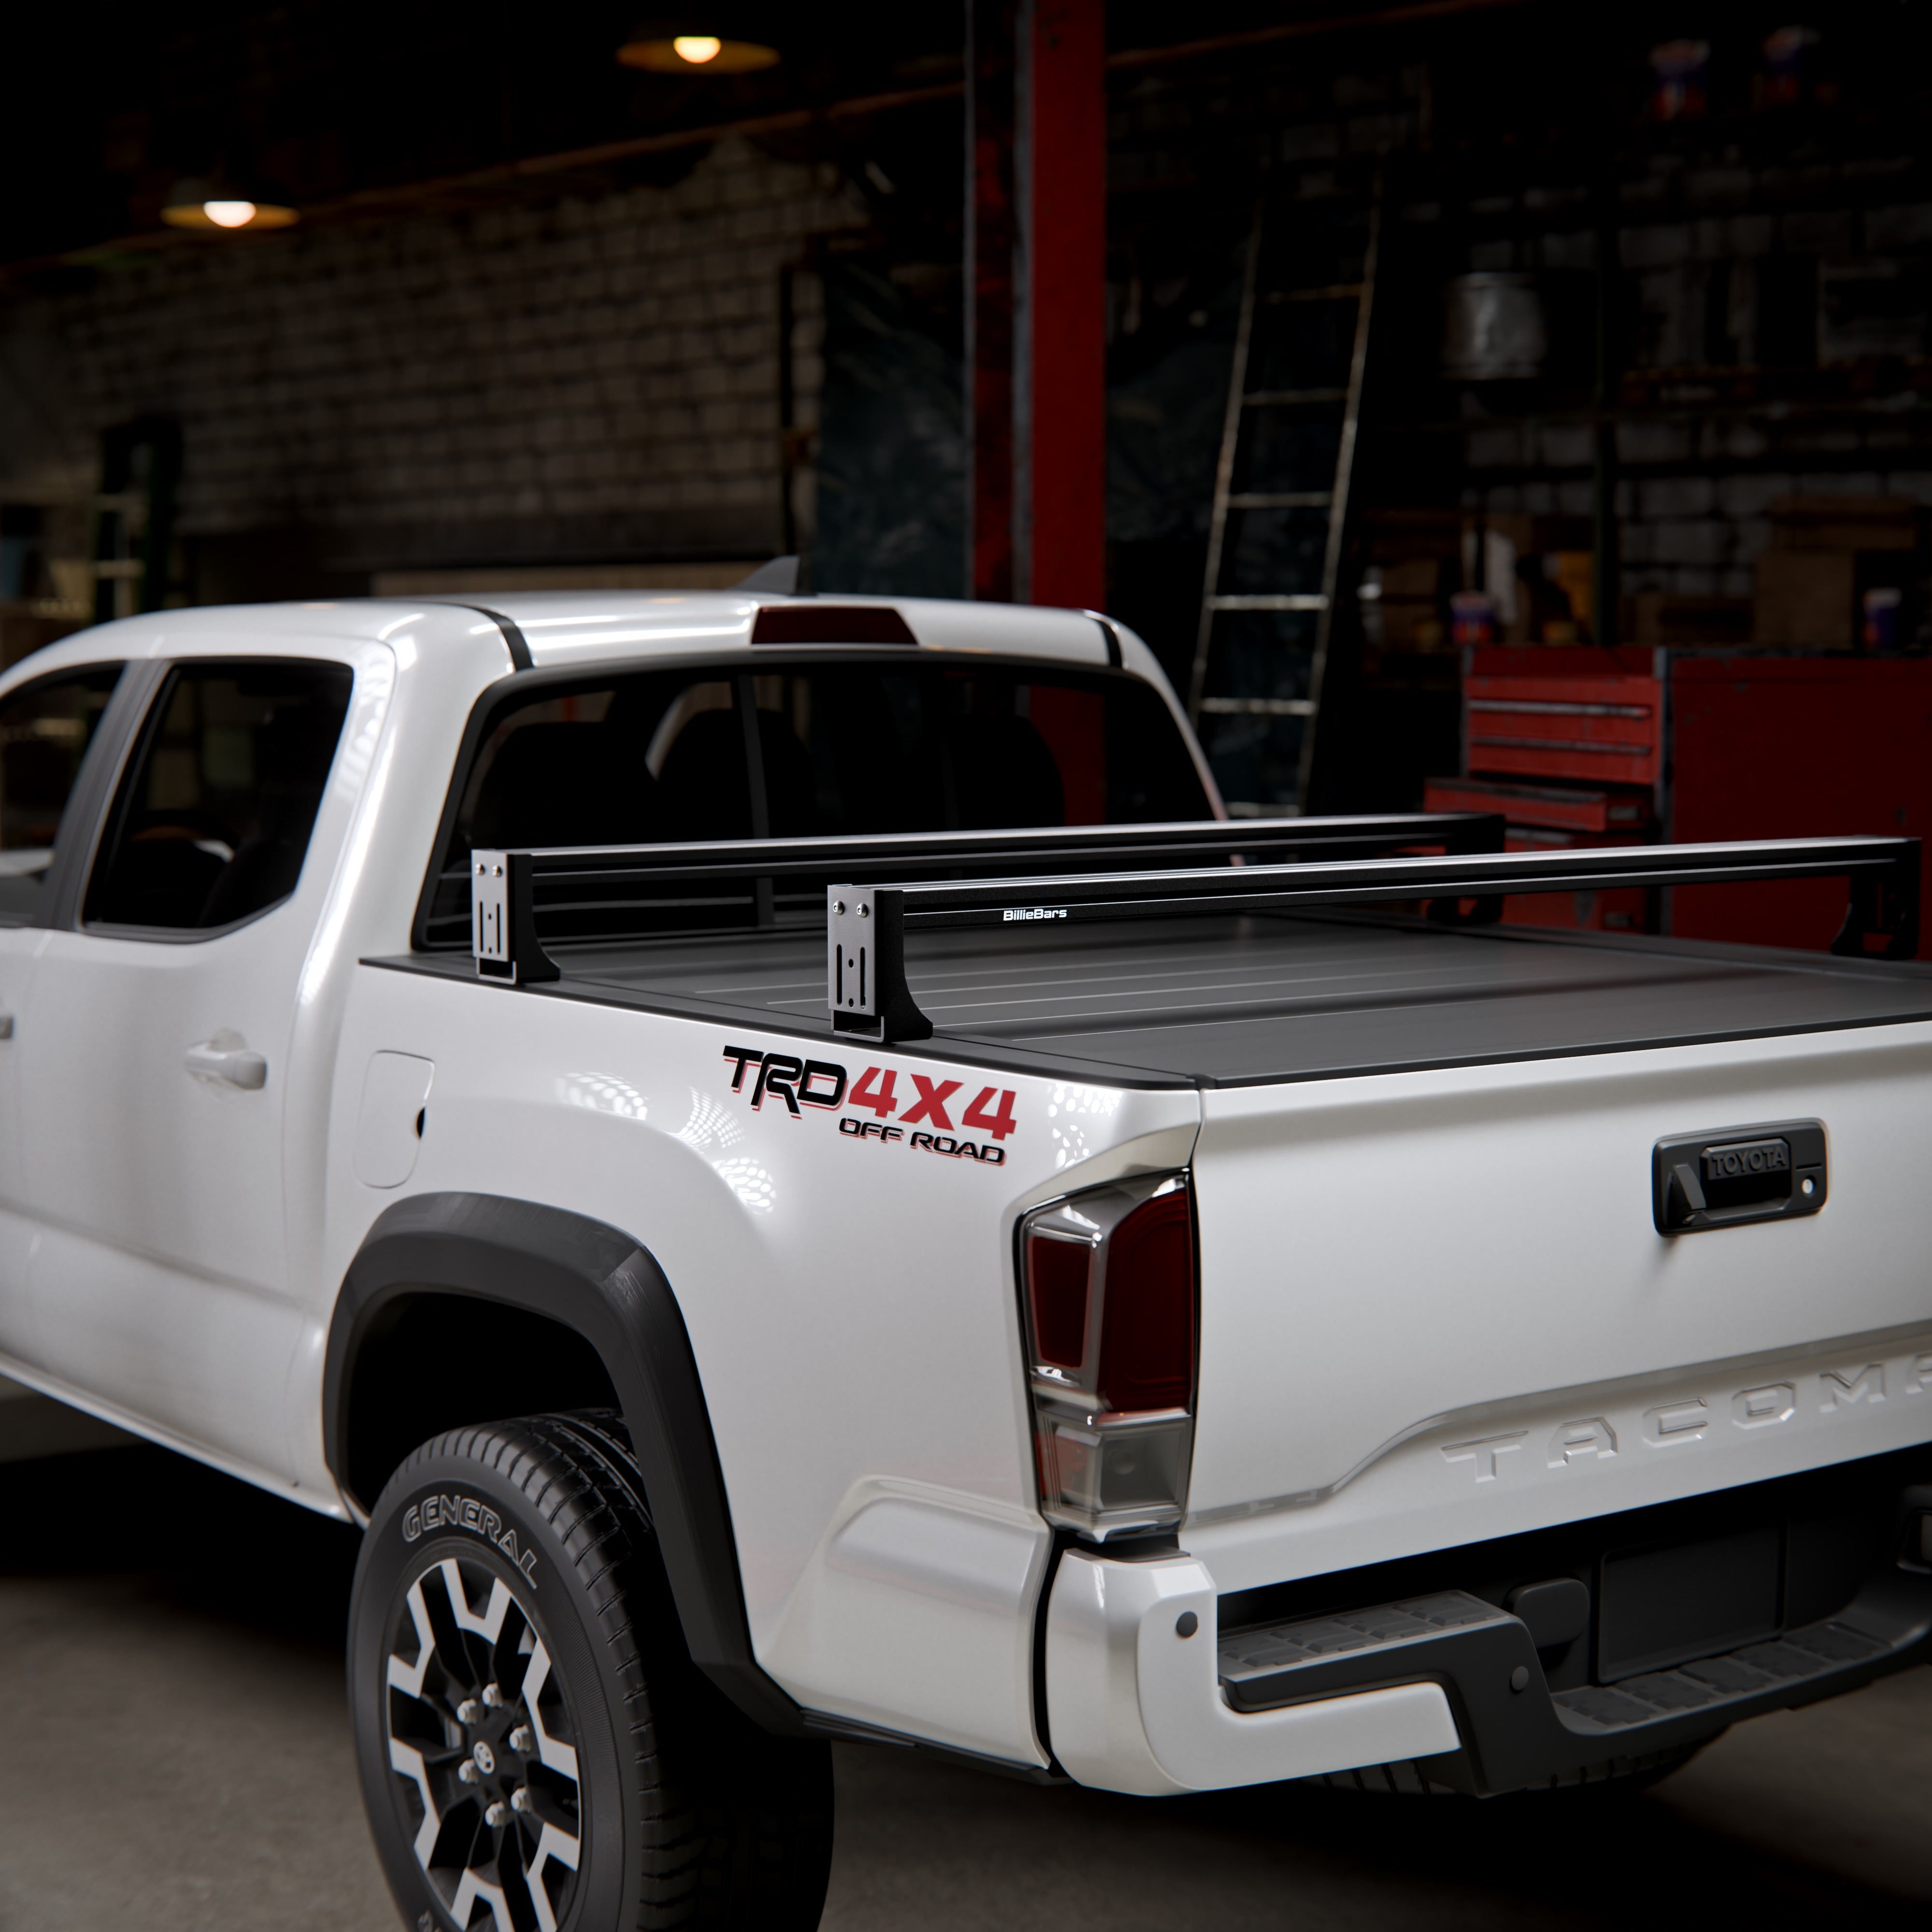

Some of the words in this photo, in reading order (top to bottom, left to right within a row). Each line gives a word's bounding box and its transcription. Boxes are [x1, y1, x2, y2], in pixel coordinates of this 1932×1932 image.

[1003, 909, 1067, 921] BillieBars
[723, 1045, 849, 1120] TRD
[839, 1118, 904, 1143] OFF
[910, 1131, 1006, 1166] ROAD
[1711, 1146, 1787, 1176] TOYOTA
[402, 1494, 537, 1590] GENERAL
